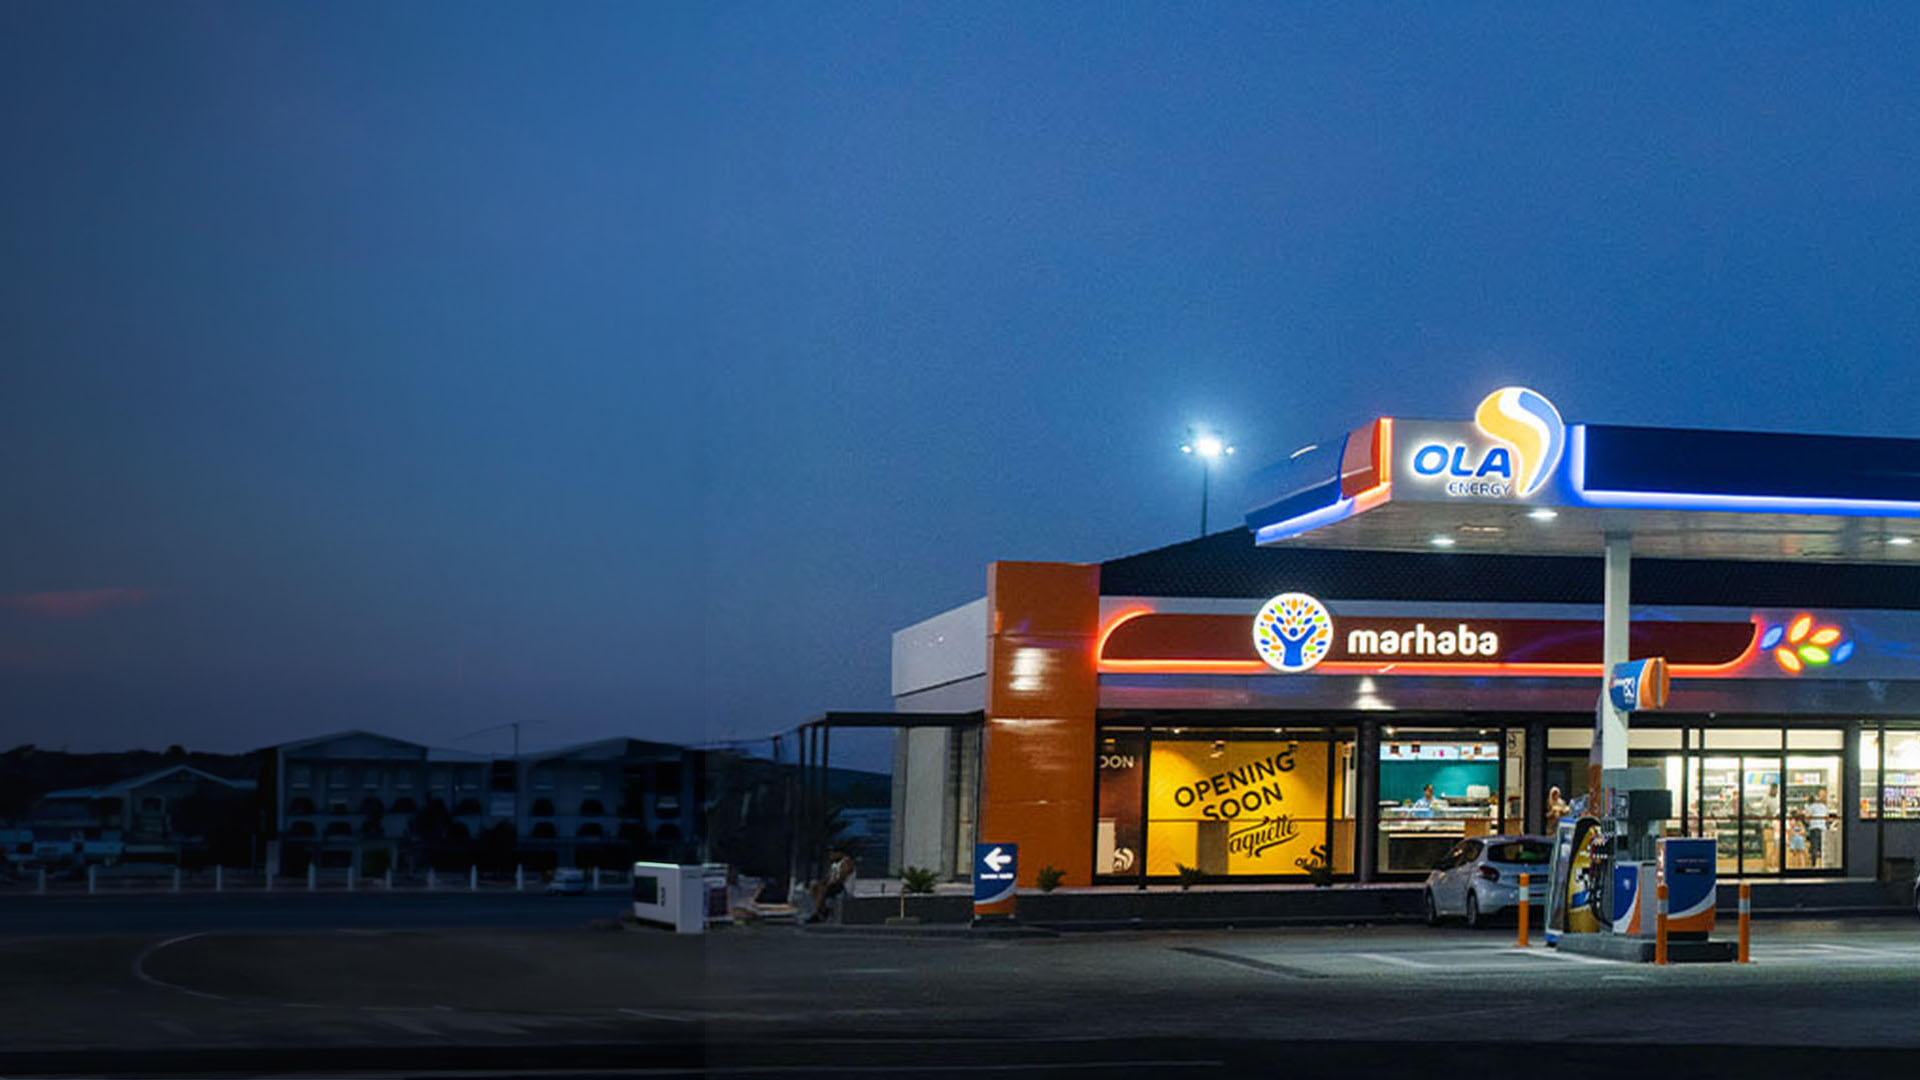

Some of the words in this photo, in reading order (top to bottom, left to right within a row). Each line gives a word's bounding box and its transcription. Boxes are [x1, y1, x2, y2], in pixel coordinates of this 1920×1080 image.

[1413, 445, 1511, 478] OLA
[1447, 481, 1511, 496] ENERGY
[1348, 623, 1498, 655] marhaba
[1099, 755, 1134, 769] OON
[1174, 751, 1295, 808] OPENING
[1202, 781, 1283, 822] SOON
